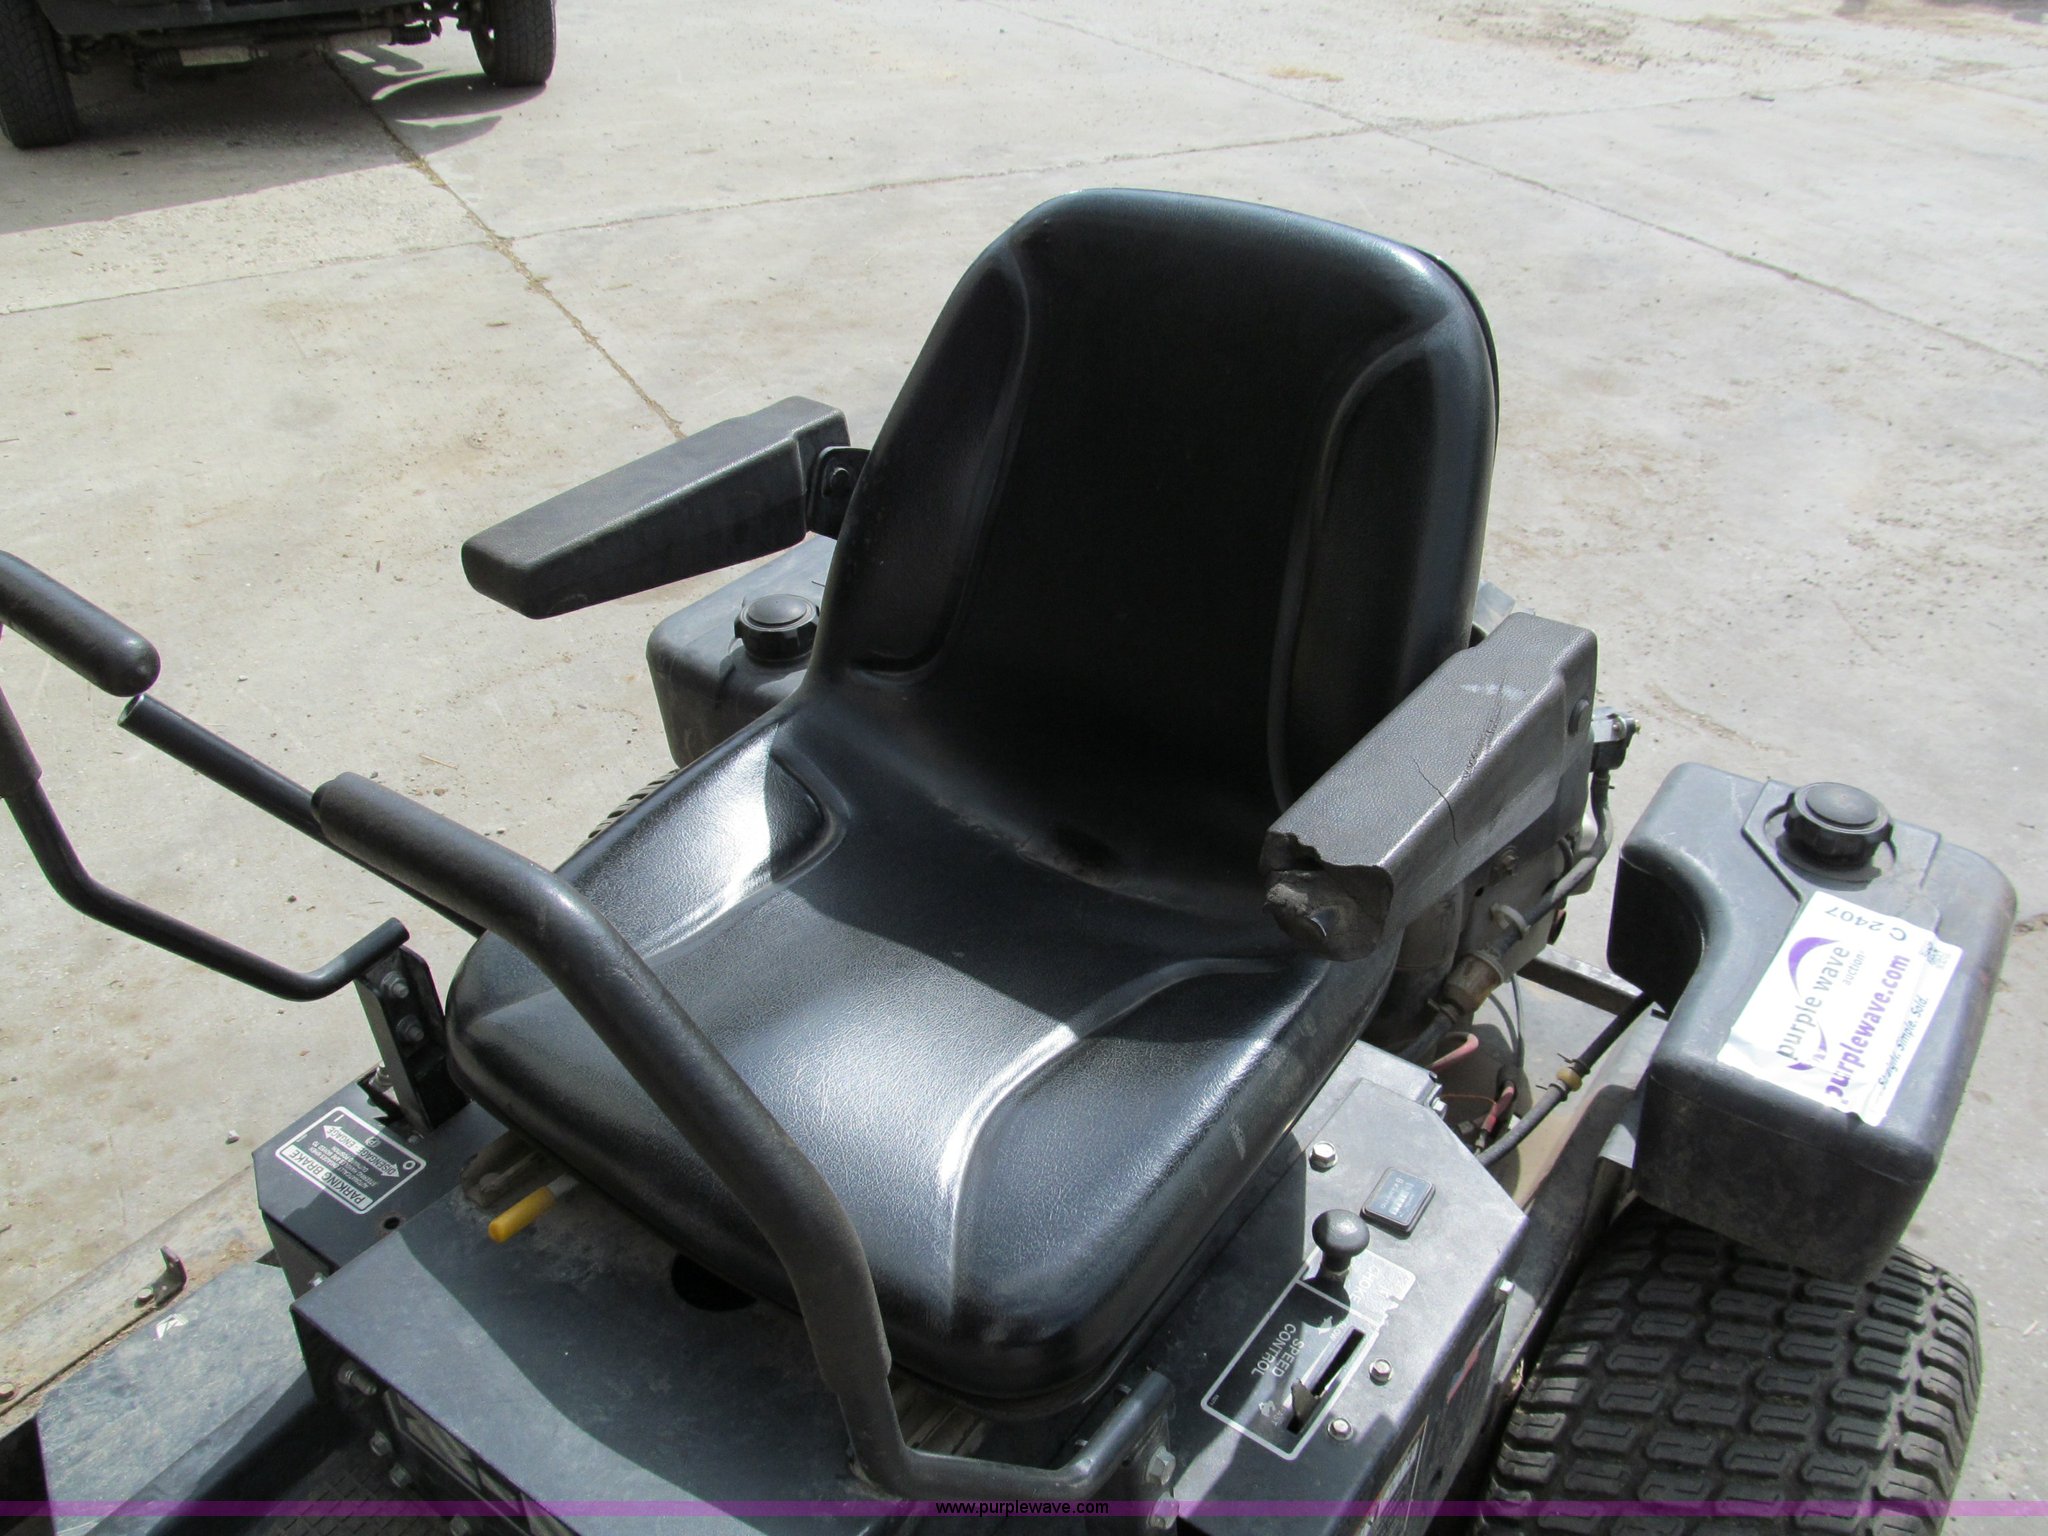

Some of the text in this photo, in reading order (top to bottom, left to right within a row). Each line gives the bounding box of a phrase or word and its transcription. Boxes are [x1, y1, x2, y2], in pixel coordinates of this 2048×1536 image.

[1825, 906, 1885, 931] 2407
[1841, 952, 1865, 986] auction
[1776, 945, 1850, 1060] purple wave
[1911, 994, 1928, 1018] Sold.
[1824, 952, 1911, 1105] purplewave.com
[328, 1127, 356, 1149] ENGAGE
[289, 1149, 366, 1205] PARKING BRAKE
[357, 1147, 396, 1176] DISENGAGE
[1349, 1263, 1381, 1304] CHOKE
[1250, 1322, 1297, 1377] CONTROL
[1271, 1337, 1305, 1379] SPEED
